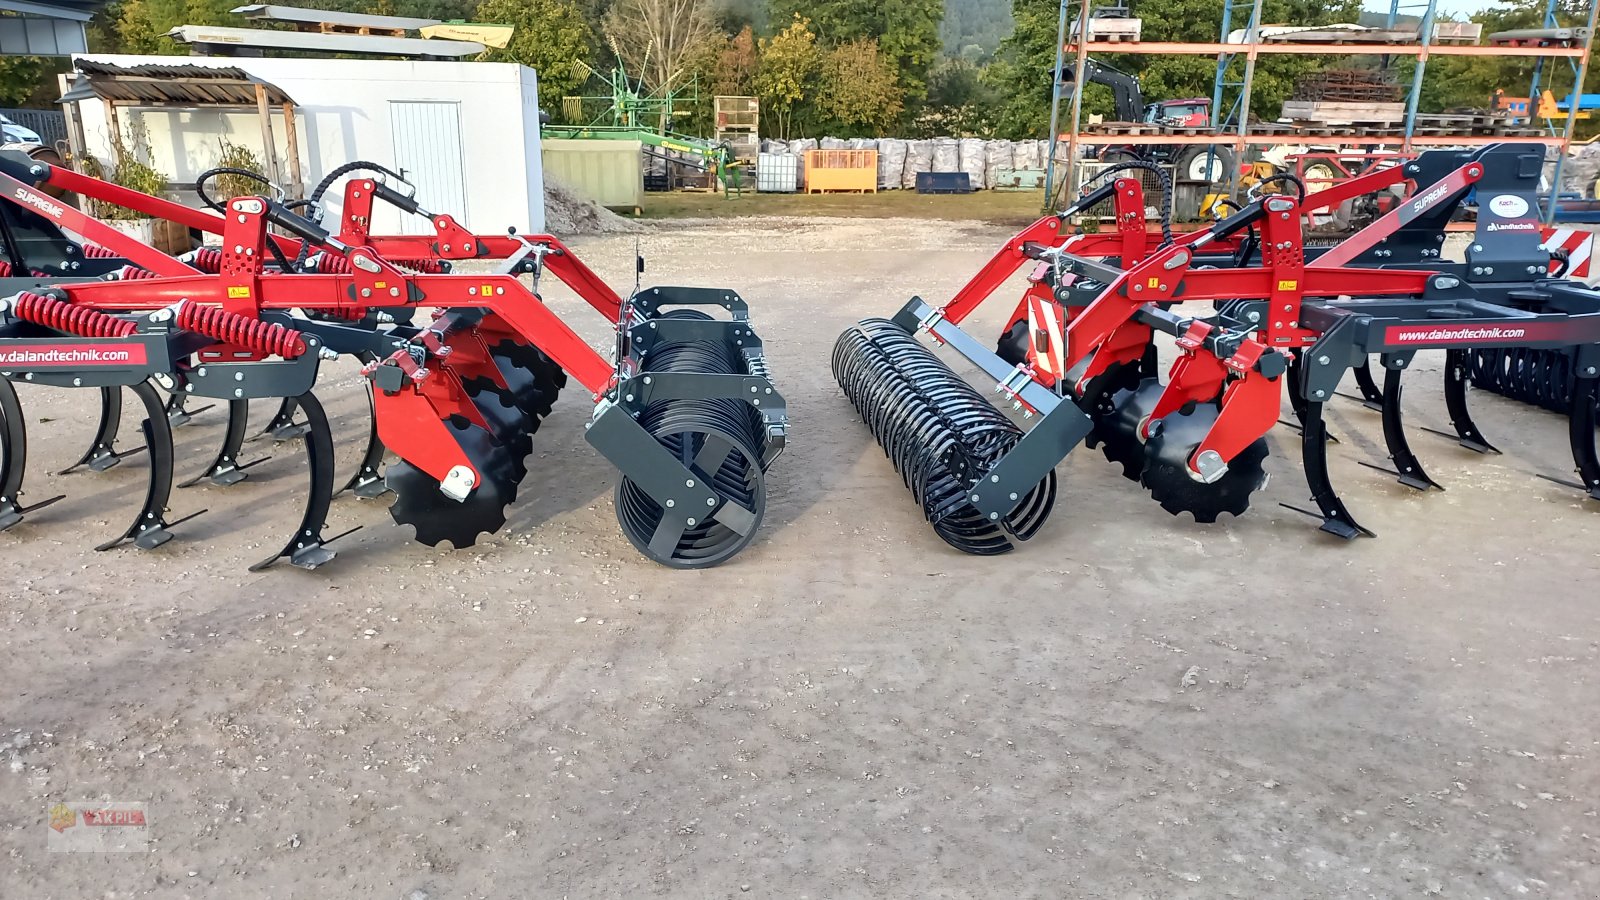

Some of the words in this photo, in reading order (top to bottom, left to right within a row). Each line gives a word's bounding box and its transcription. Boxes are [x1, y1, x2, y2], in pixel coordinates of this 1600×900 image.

[14, 187, 65, 219] SUPREME
[1413, 183, 1449, 213] SUPREME
[1399, 327, 1526, 341] www.dalandtechnik.com
